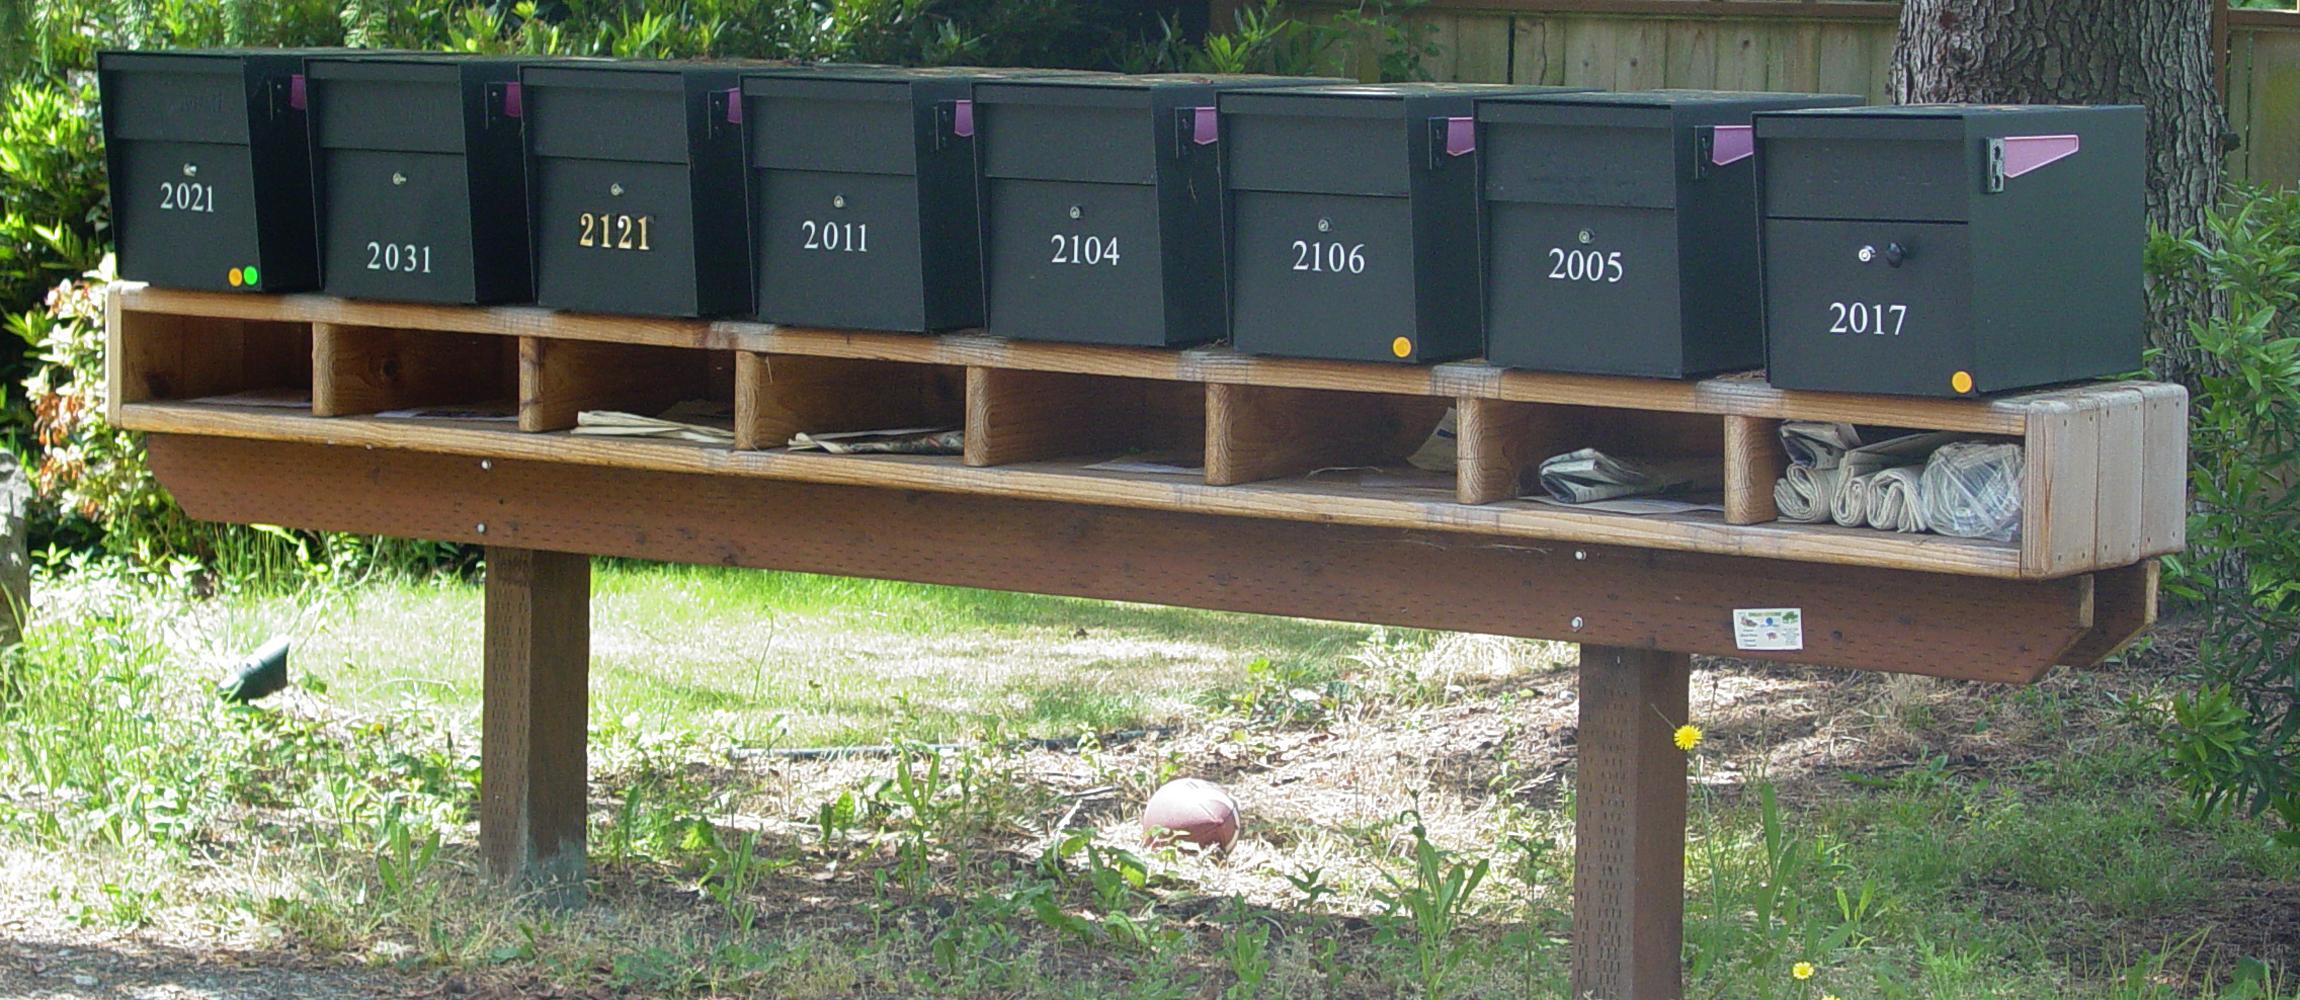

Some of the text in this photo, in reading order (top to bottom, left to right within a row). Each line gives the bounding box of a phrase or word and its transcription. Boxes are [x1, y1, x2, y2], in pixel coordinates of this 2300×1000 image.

[161, 182, 214, 212] 2021
[580, 213, 651, 251] 2121
[802, 221, 868, 252] 2011
[367, 242, 431, 274] 2031
[1051, 234, 1121, 266] 2104
[1292, 241, 1366, 274] 2106
[1549, 248, 1624, 282] 2005
[1829, 302, 1907, 335] 2017
